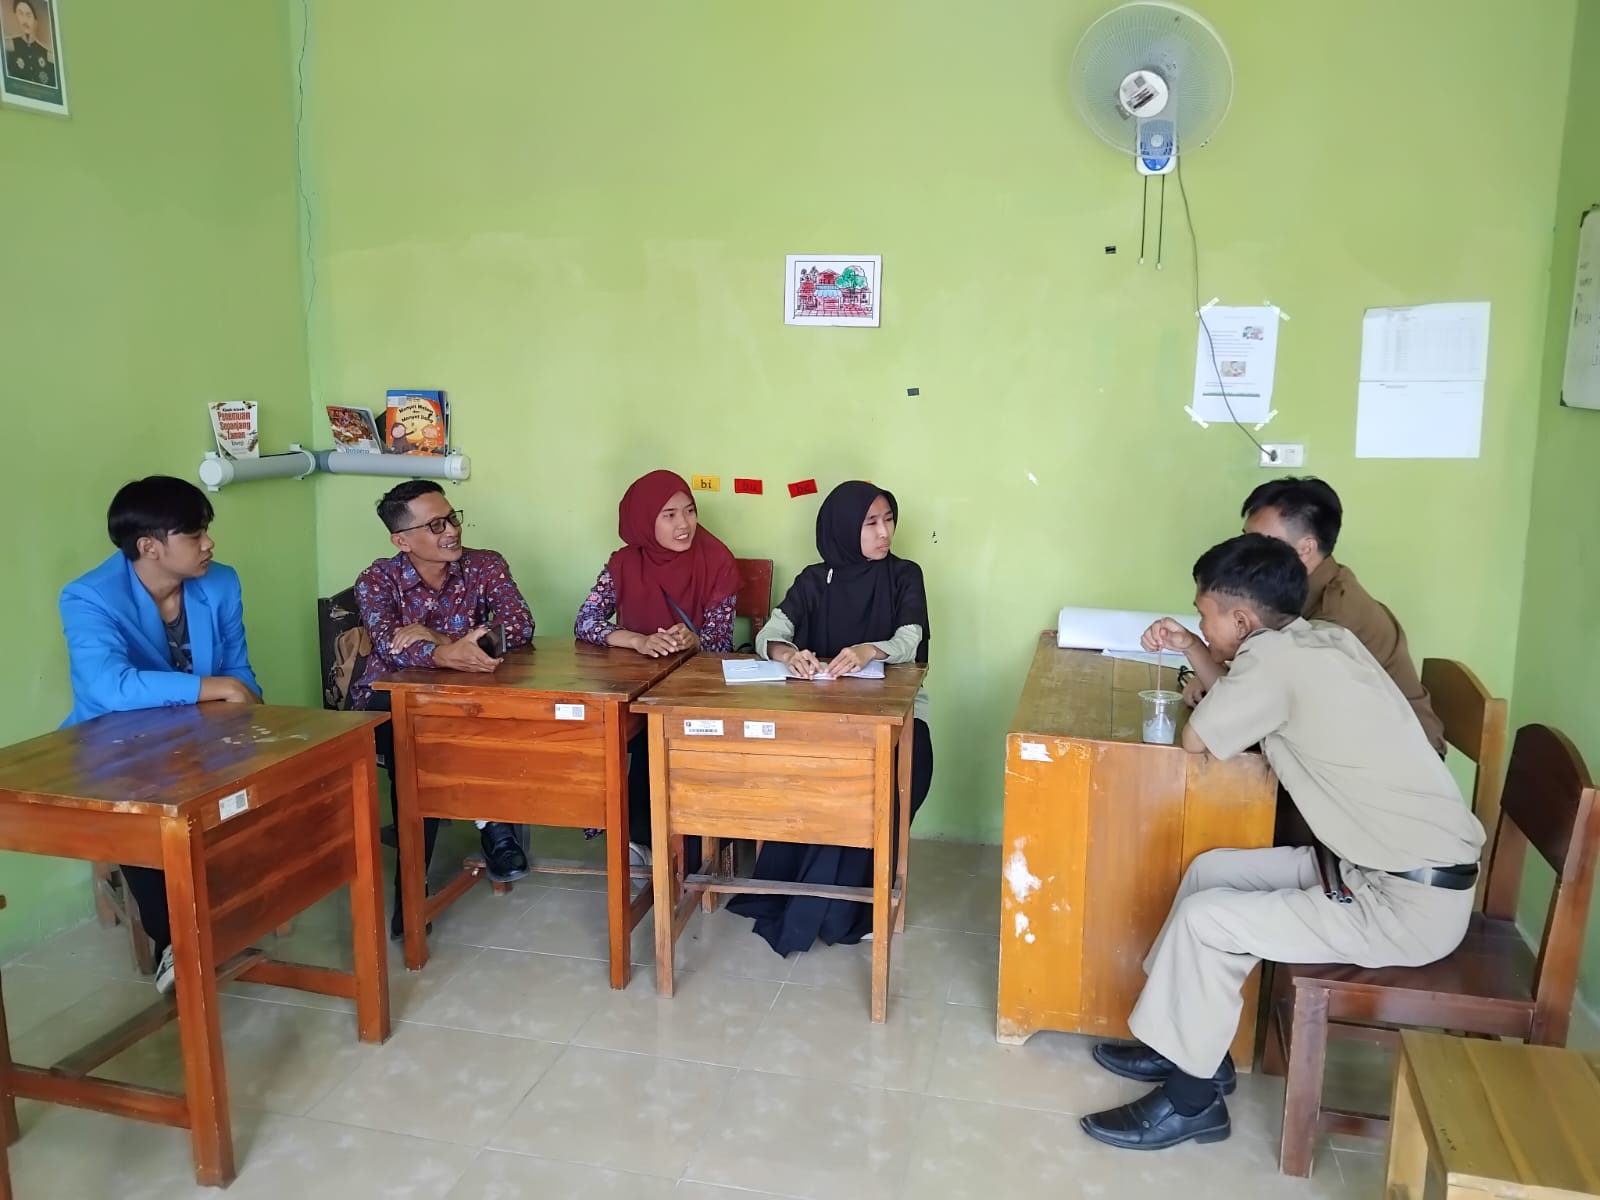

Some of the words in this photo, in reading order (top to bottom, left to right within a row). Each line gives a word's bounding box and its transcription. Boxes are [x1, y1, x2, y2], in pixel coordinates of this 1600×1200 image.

[217, 411, 250, 421] Penemuan
[220, 421, 251, 431] Sepanjang
[700, 479, 712, 489] bi
